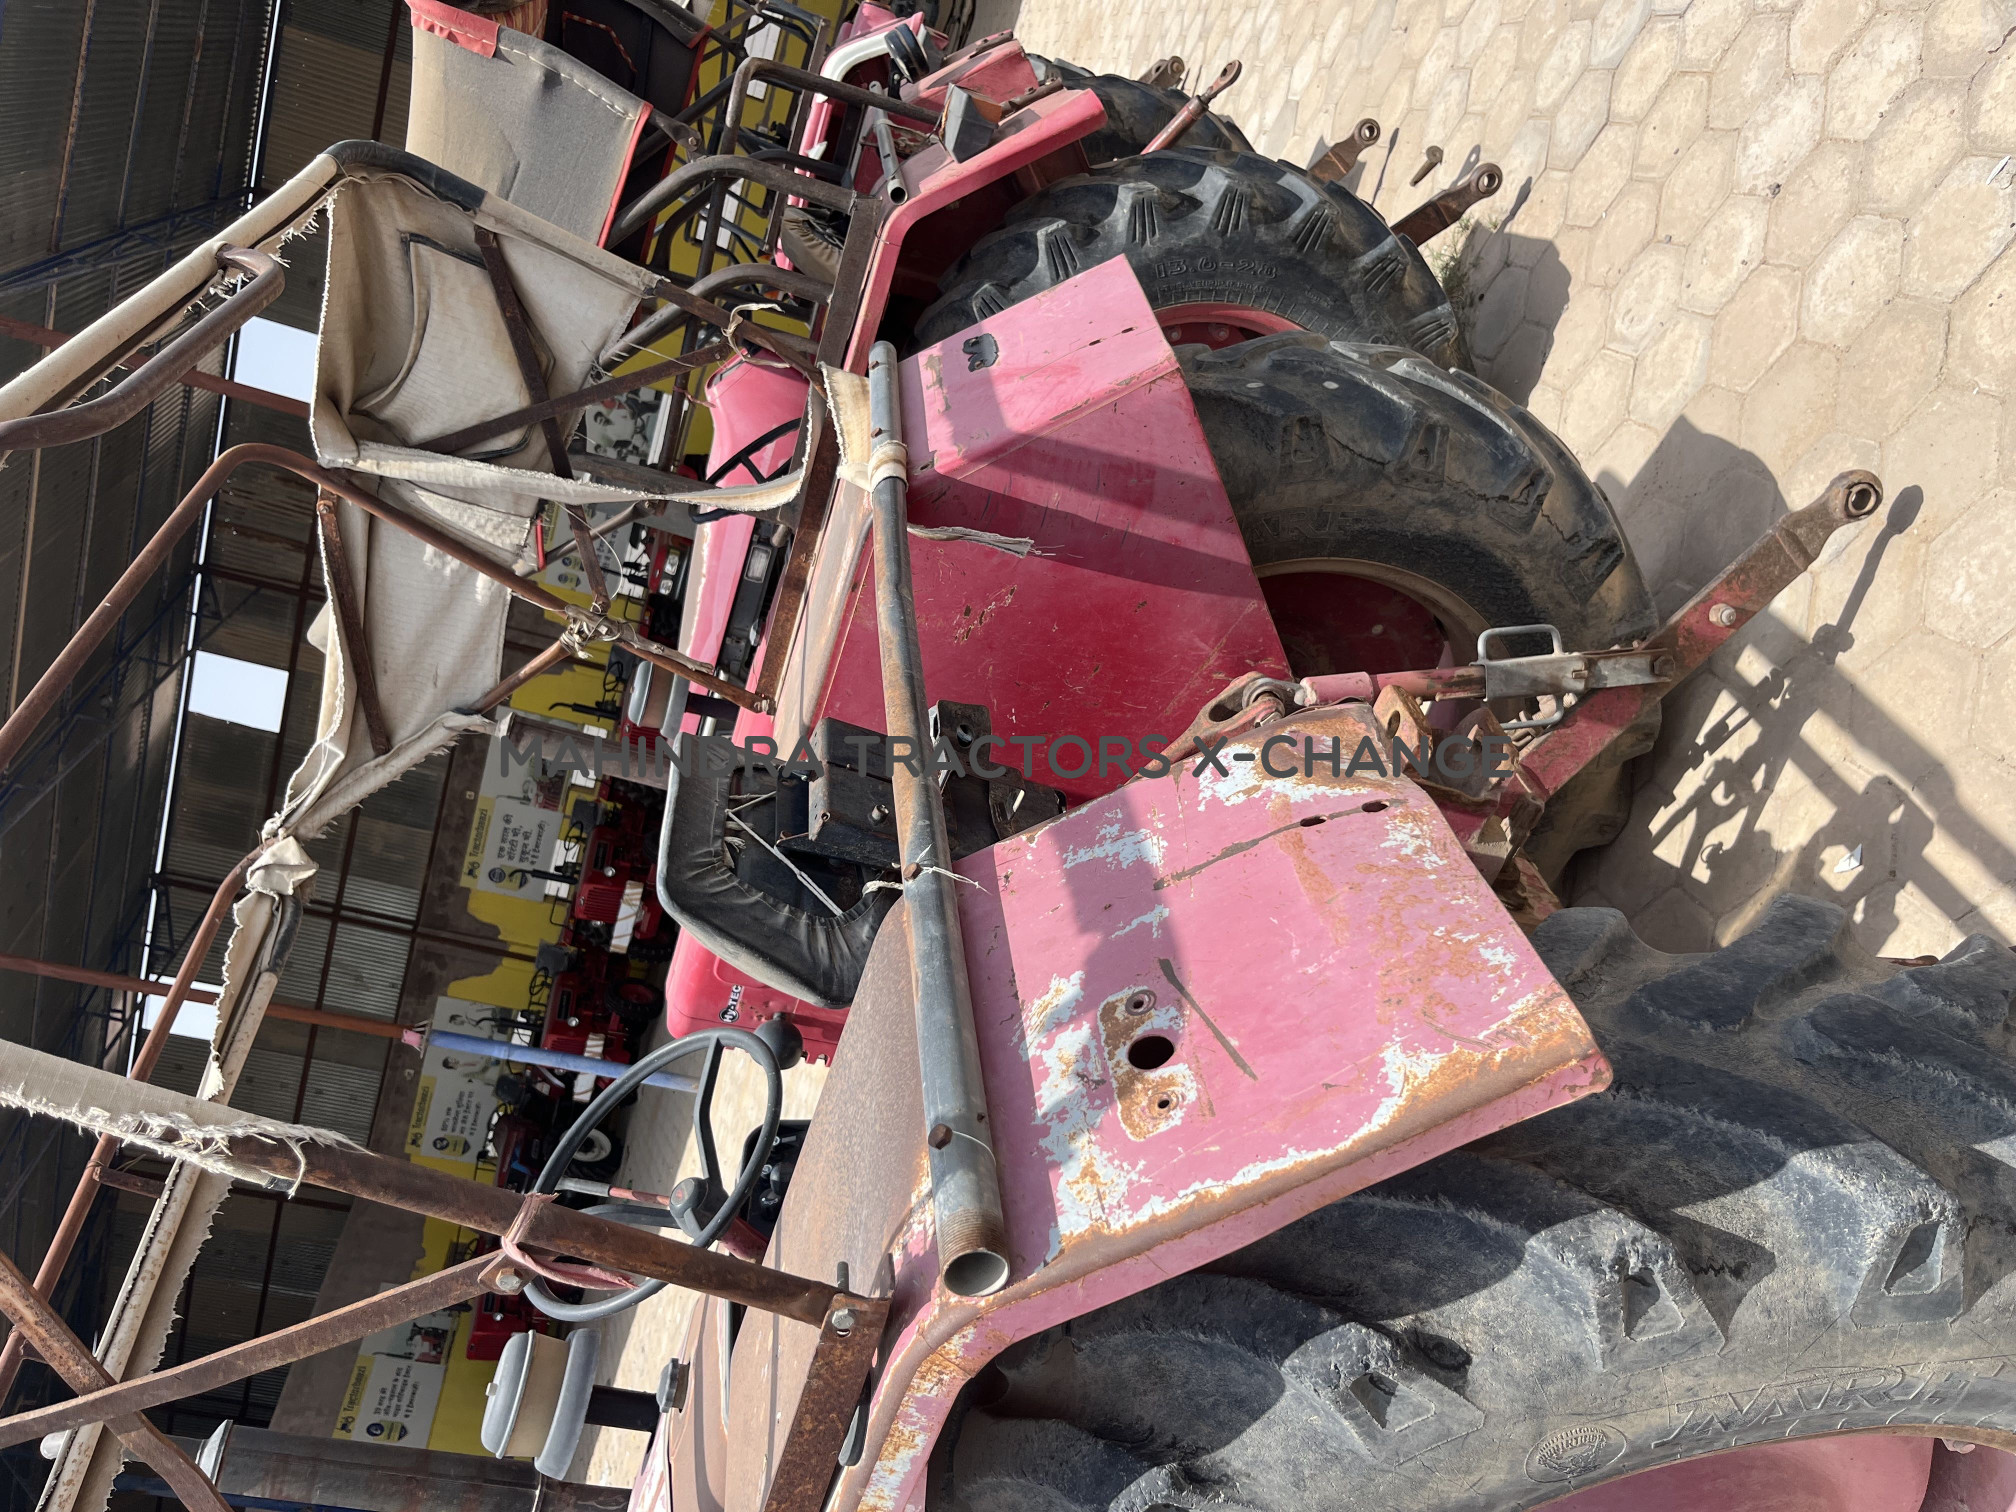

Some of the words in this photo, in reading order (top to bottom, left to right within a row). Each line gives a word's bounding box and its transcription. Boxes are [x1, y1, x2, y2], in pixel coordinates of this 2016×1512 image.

[496, 846, 506, 859] एक
[503, 814, 514, 825] की
[721, 985, 742, 1022] Hy-TEC
